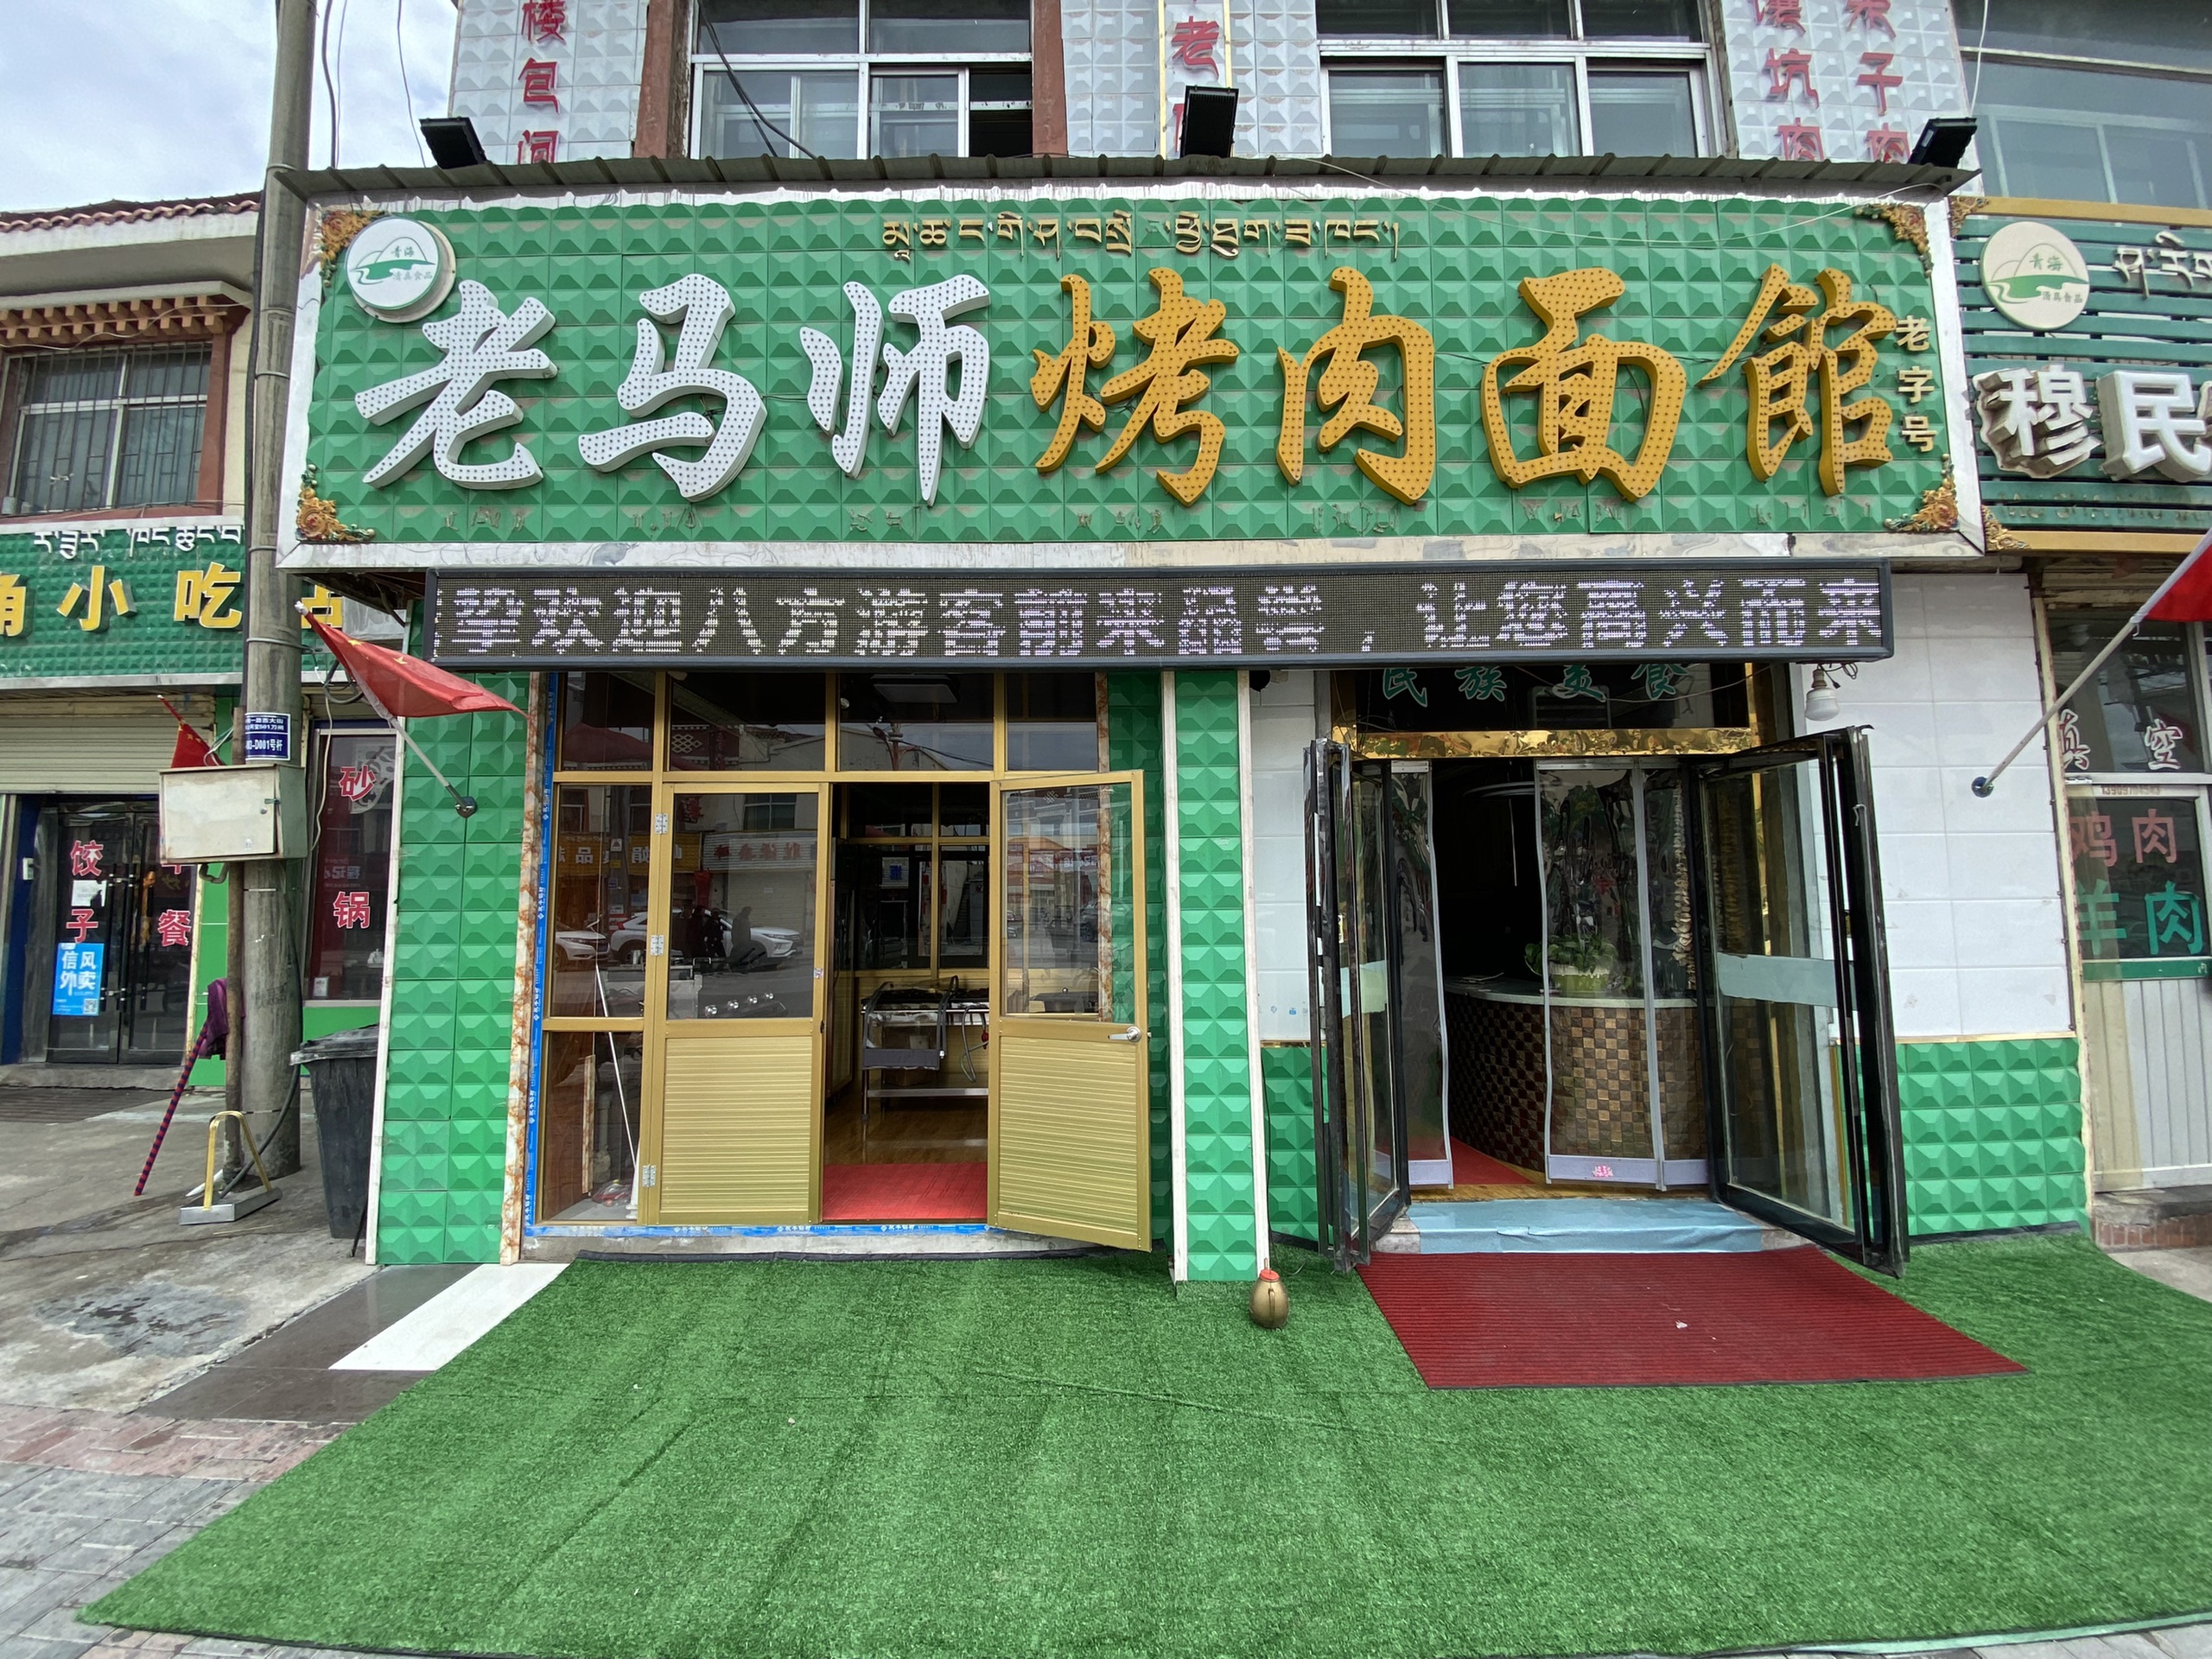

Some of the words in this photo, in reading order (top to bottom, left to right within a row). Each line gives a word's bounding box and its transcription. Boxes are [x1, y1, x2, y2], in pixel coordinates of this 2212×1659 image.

[391, 245, 415, 258] 青海
[2029, 253, 2064, 272] 青海
[1895, 315, 1938, 453] 老字号
[334, 765, 376, 929] 砂锅
[66, 839, 104, 944] 饺子
[2076, 879, 2203, 956] 羊肉
[60, 970, 97, 995] 外卖
[61, 950, 97, 969] 信风
